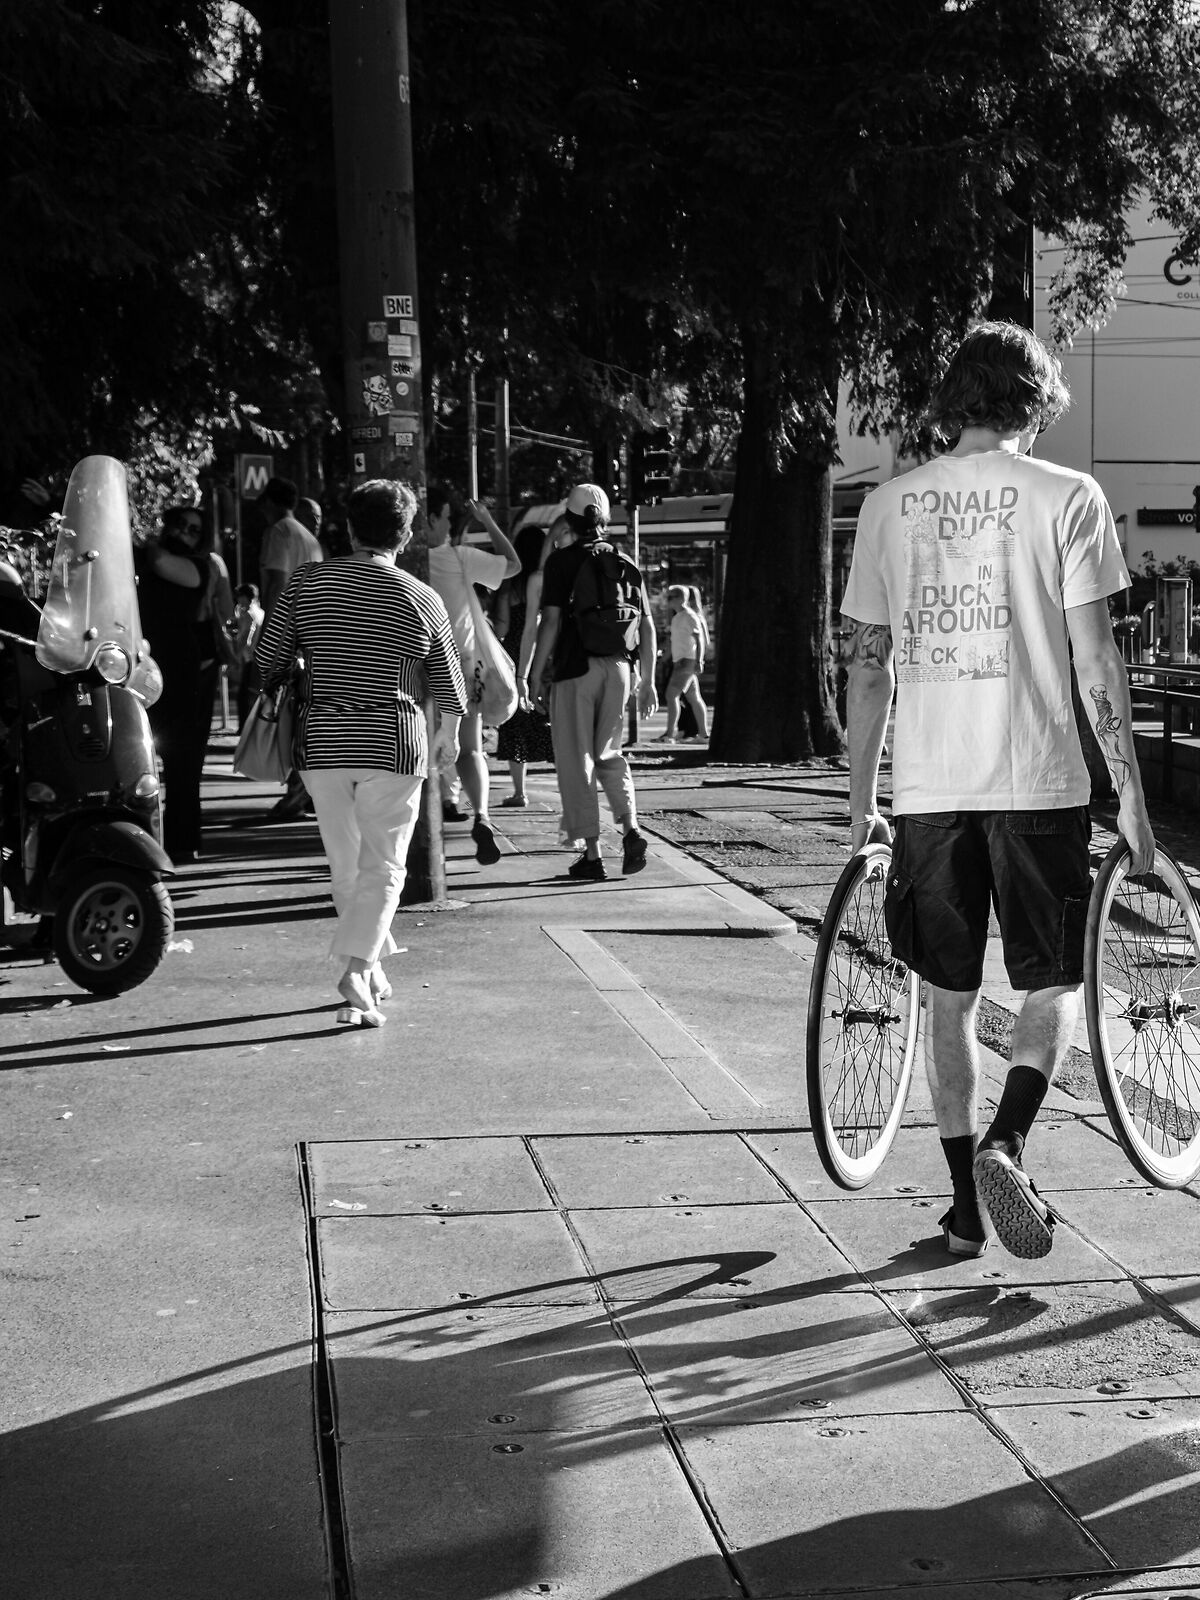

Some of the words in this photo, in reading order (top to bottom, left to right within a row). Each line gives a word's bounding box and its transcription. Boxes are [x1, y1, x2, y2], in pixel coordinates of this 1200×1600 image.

[387, 298, 411, 314] BNE
[244, 465, 269, 491] M
[901, 486, 1019, 516] DONALD
[938, 511, 1016, 540] DUCK
[978, 563, 992, 580] IN
[922, 582, 991, 608] DUCK
[902, 605, 1013, 634] AROUND
[901, 637, 922, 648] HE
[898, 647, 959, 666] CLCK
